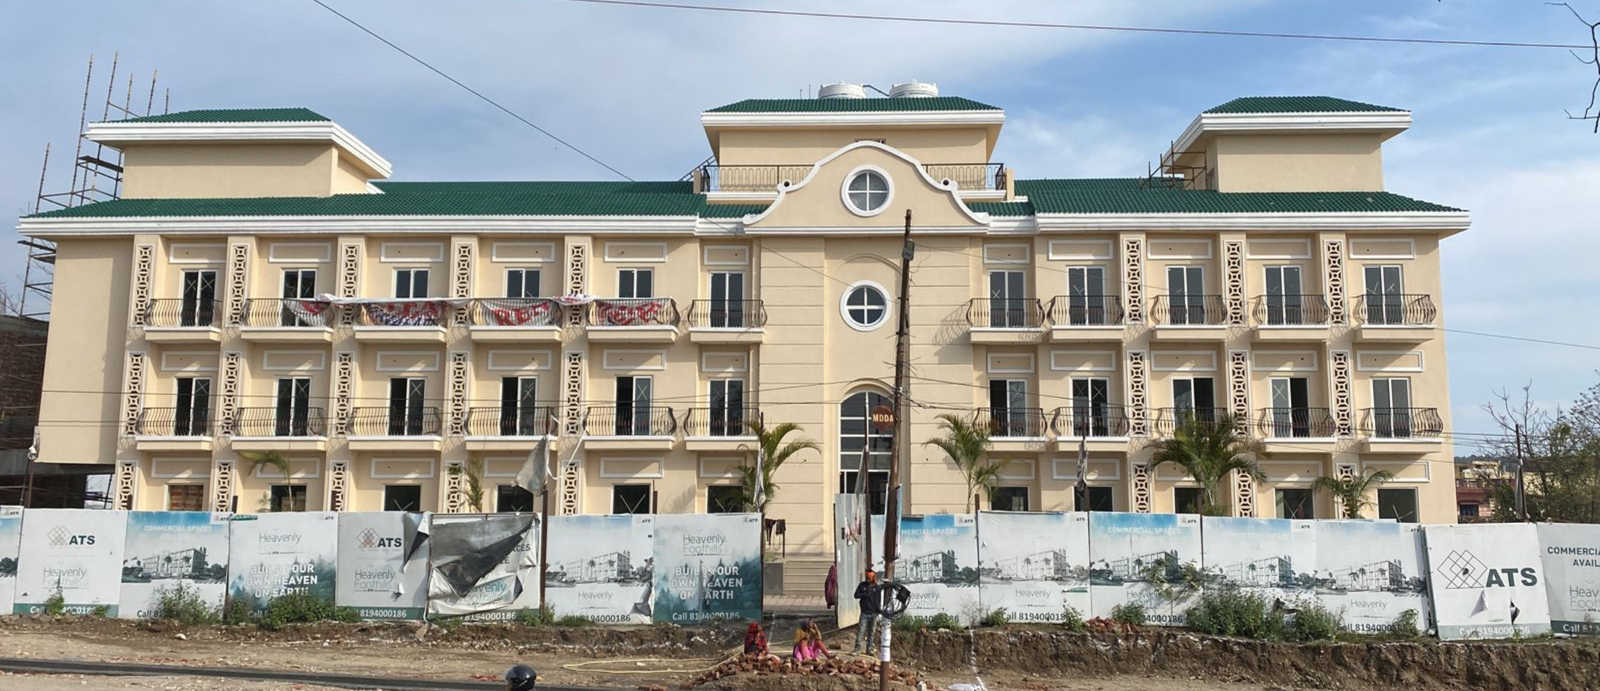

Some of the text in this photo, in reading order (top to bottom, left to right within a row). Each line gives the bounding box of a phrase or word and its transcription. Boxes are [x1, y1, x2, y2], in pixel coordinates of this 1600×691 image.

[901, 528, 929, 536] MERCIAL
[1107, 526, 1151, 534] COMMERCIAL
[69, 535, 96, 546] ATS
[258, 533, 302, 545] Heavenly
[377, 537, 402, 548] ATS
[683, 534, 726, 547] Heavenly
[1572, 558, 1600, 568] AVAIL
[43, 567, 87, 580] Heavenly
[250, 564, 315, 575] BUILD YOUR
[675, 566, 740, 576] BUILD YOUR
[354, 569, 395, 581] Heavenly
[1485, 567, 1538, 588] ATS
[246, 575, 318, 587] OWN HEAVEN
[671, 578, 696, 588] OWN
[255, 588, 270, 598] ON
[578, 591, 613, 602] Heavenly
[705, 590, 734, 600] ARTH
[910, 591, 940, 602] eavenly
[1015, 588, 1051, 599] Heavenly
[1350, 599, 1387, 611] Heavenly
[137, 609, 152, 618] Call
[360, 609, 407, 619] 8194000186
[672, 612, 687, 621] Call
[1001, 612, 1067, 621] Call 819400018
[1459, 627, 1475, 636] Call
[1563, 624, 1580, 632] Call
